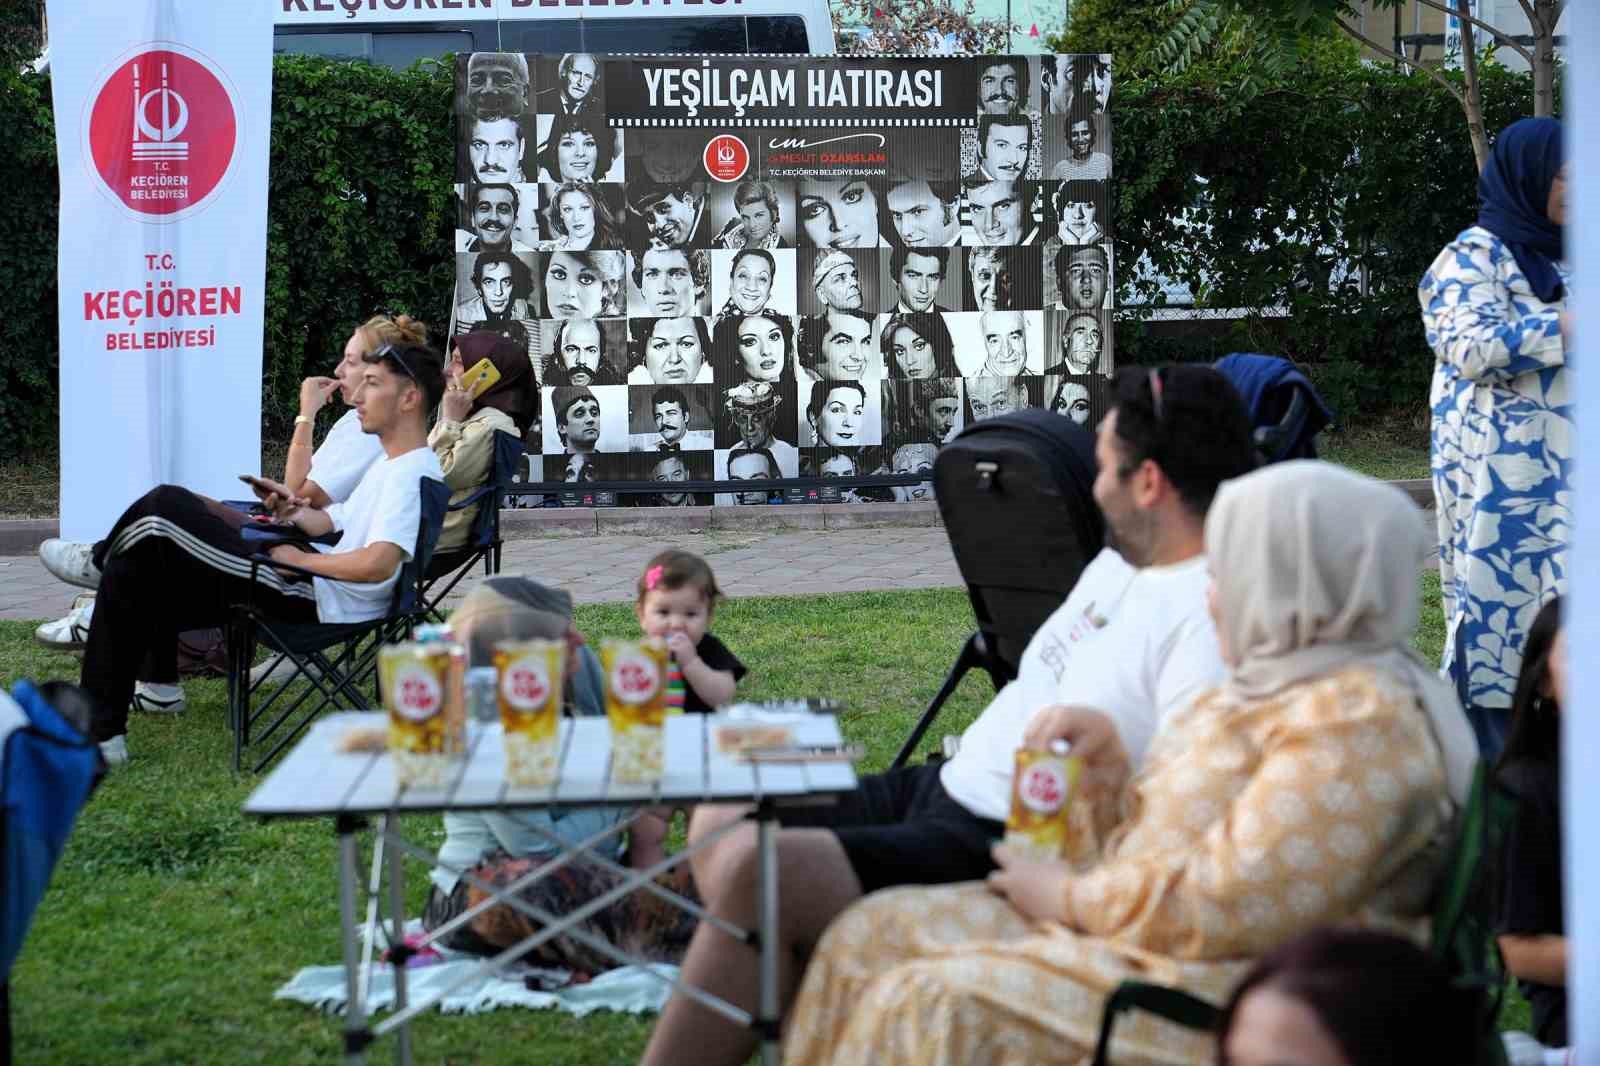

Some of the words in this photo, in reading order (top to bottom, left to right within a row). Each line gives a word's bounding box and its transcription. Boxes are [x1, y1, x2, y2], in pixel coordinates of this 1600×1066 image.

[643, 59, 796, 117] YEŞİLÇAM
[807, 68, 943, 108] HATIRASI
[144, 253, 176, 271] T.C.
[83, 280, 242, 326] KEÇİÖREN
[106, 324, 216, 351] BELEDİYESİ
